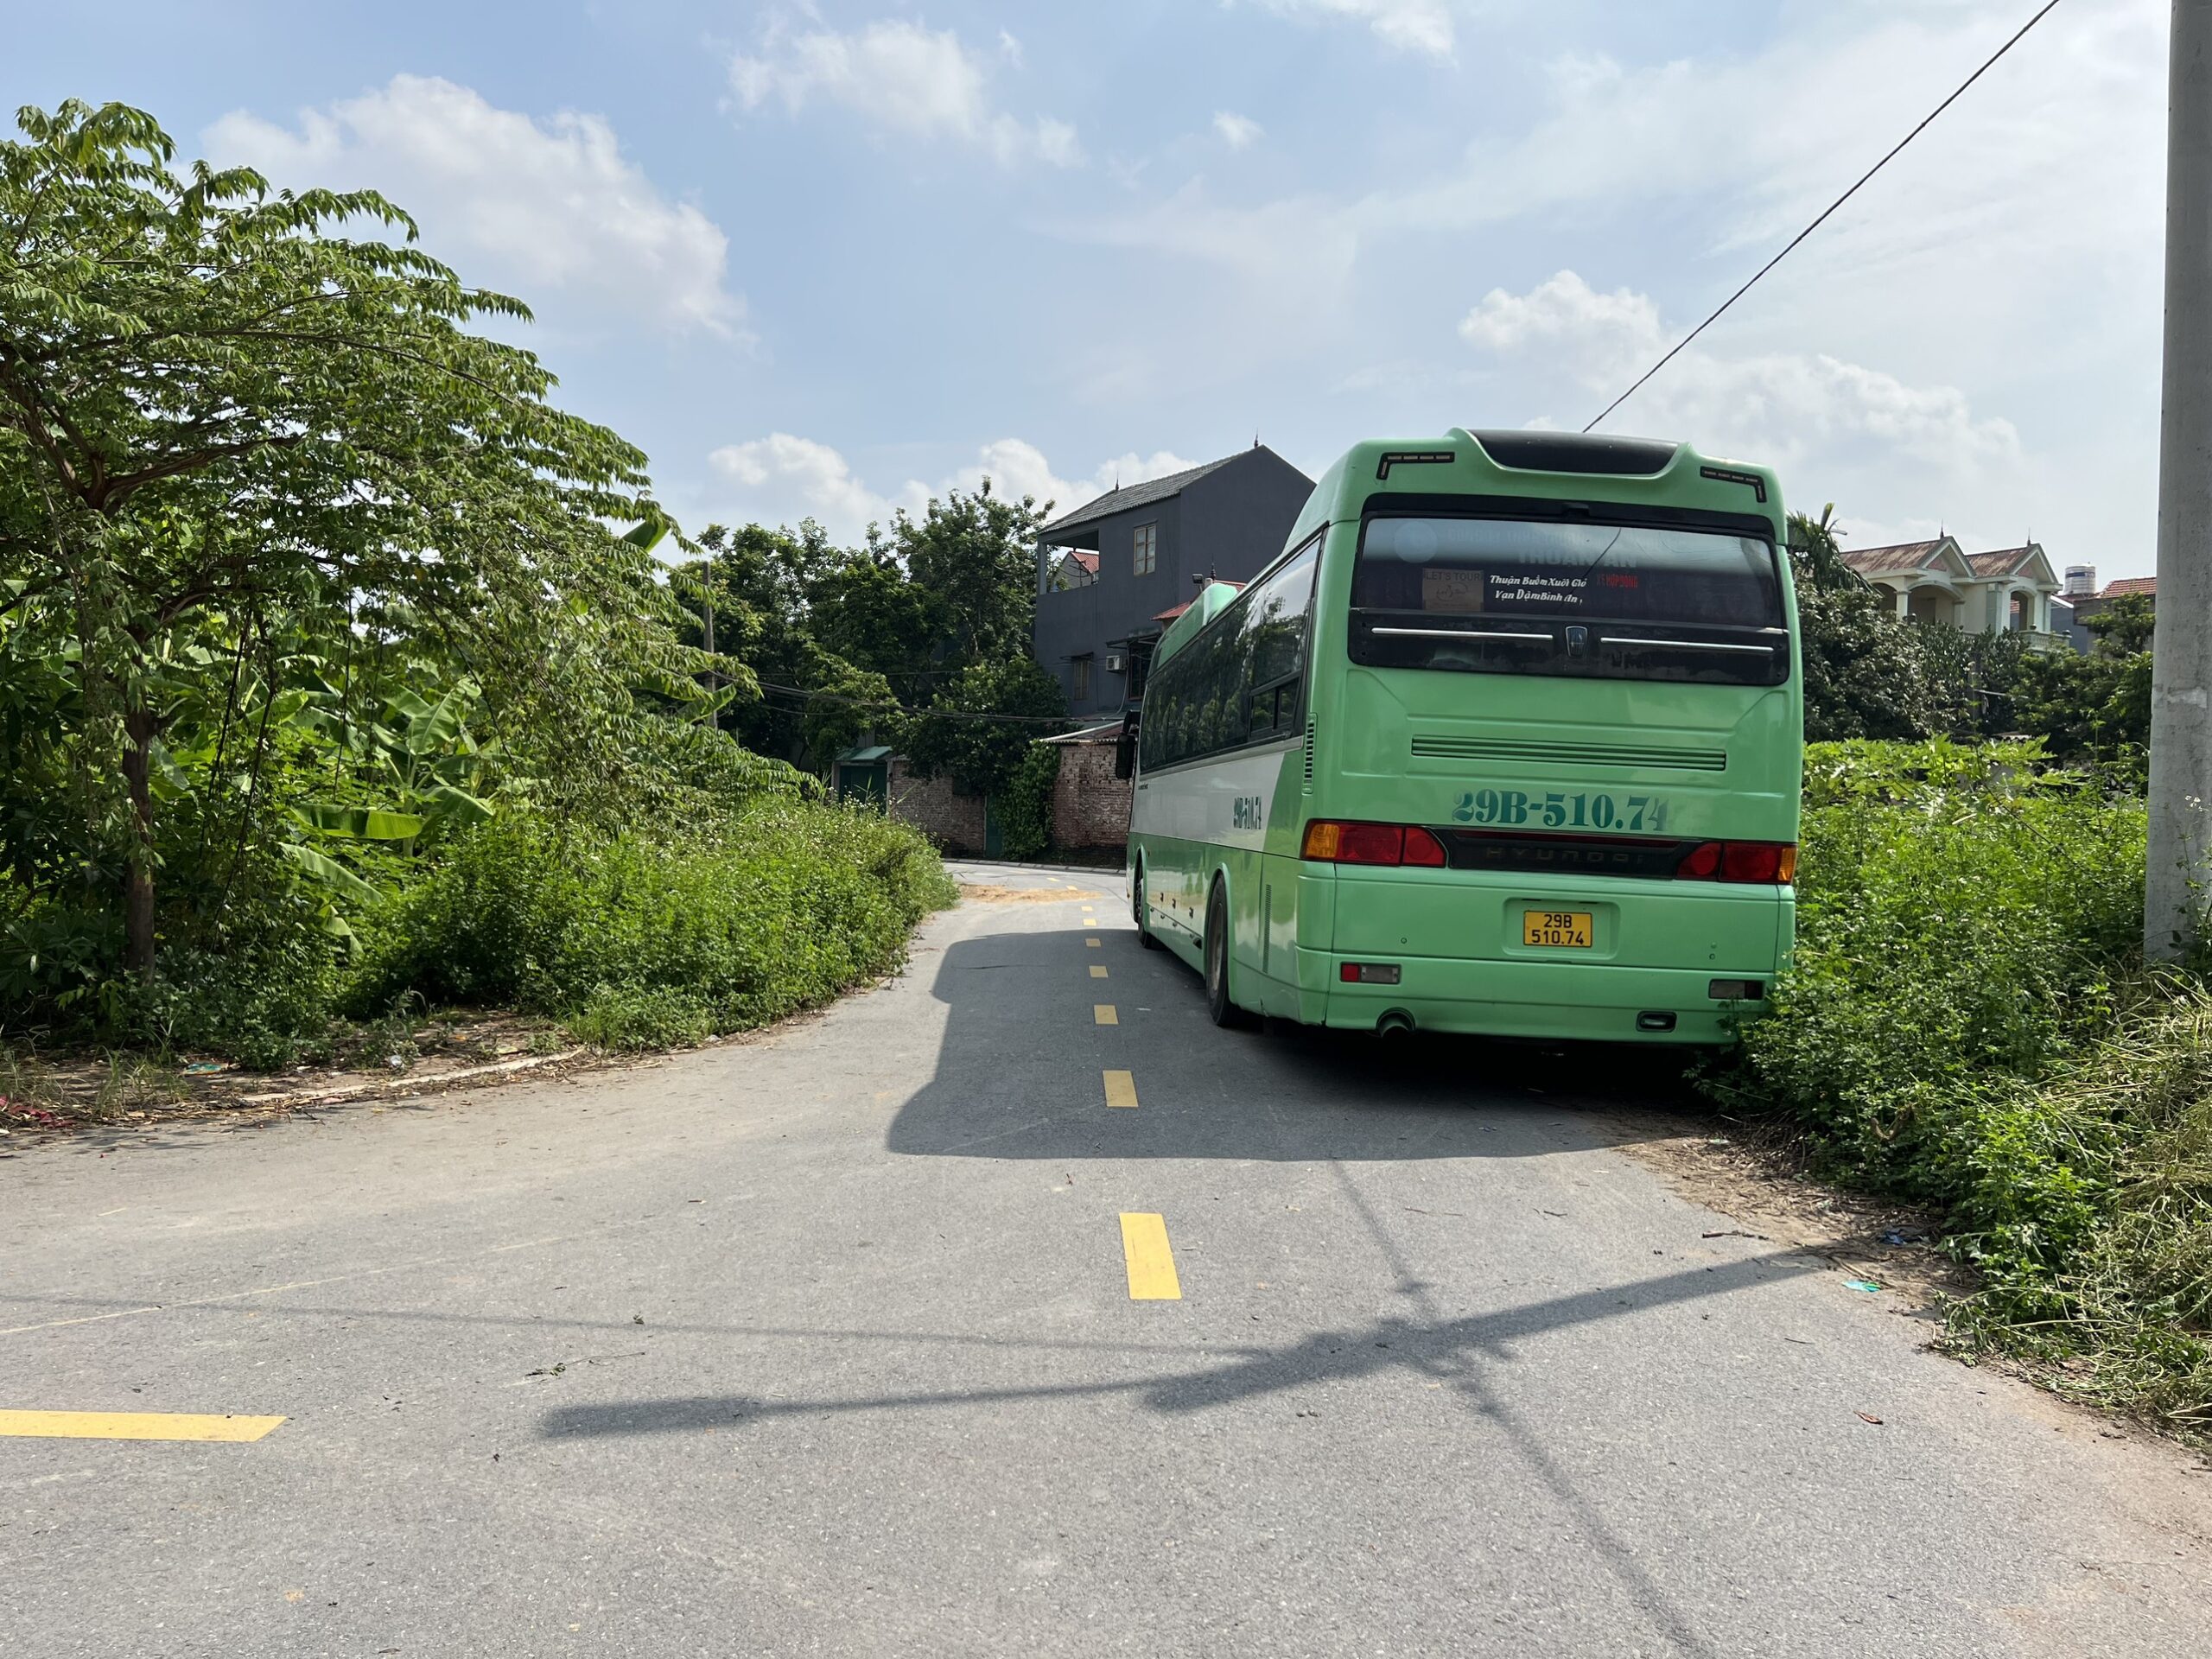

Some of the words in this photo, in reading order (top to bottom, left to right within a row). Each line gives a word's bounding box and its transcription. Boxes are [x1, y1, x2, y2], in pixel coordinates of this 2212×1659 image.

[1453, 572, 1480, 582] TOUR
[1490, 575, 1520, 586] Thuận
[1522, 575, 1548, 586] Buồm
[1495, 589, 1515, 601] Vạn
[1516, 588, 1541, 602] Dặm
[1540, 591, 1563, 601] Bình
[1452, 788, 1669, 832] 29B-510.74
[1543, 913, 1573, 929] 29B
[1531, 929, 1585, 945] 510.74
